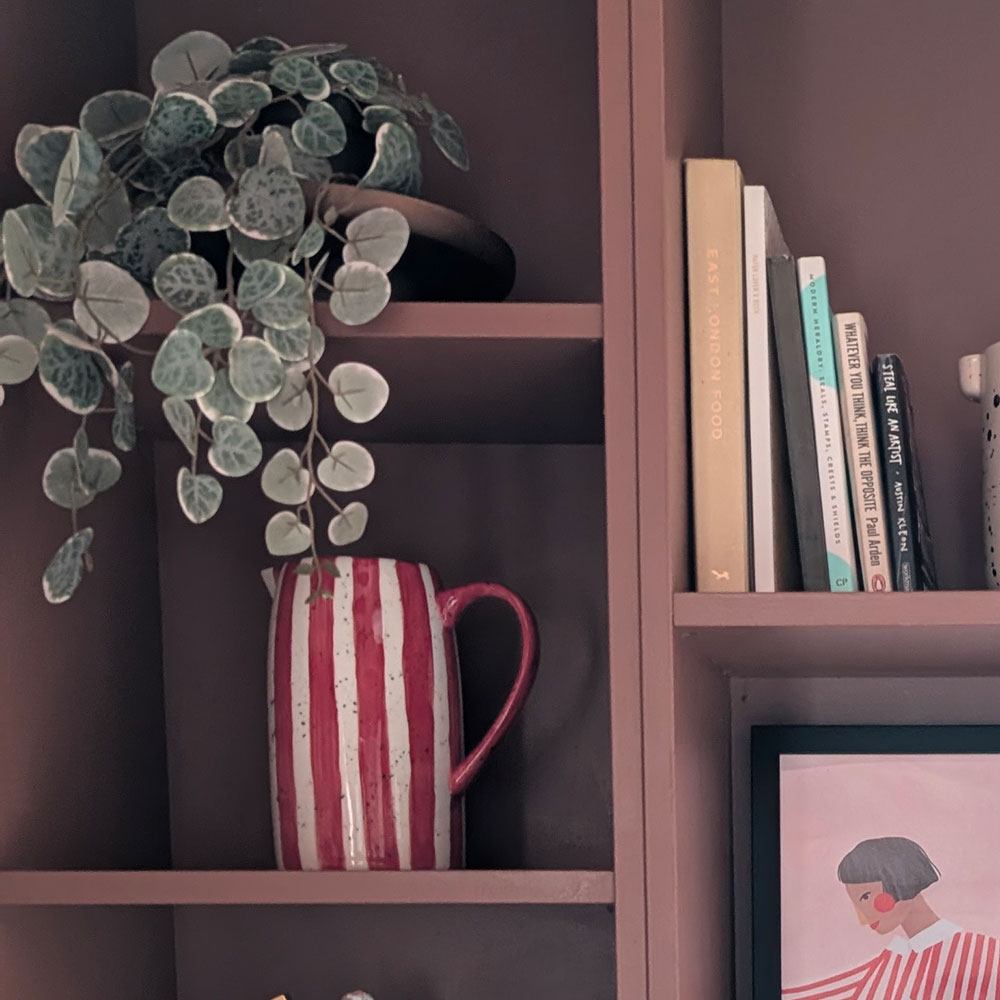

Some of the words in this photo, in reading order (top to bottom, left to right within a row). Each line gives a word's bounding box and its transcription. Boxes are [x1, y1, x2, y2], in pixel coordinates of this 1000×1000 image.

[707, 249, 720, 296] EAST
[708, 303, 722, 382] ONDON
[844, 322, 861, 370] WHATEVER
[850, 371, 863, 390] YOU
[882, 364, 897, 391] STEAL
[711, 390, 723, 440] FOOD
[809, 274, 818, 314] MODERN
[826, 456, 837, 491] CRESTS
[832, 504, 841, 545] SHIELDS
[852, 392, 867, 422] THINK,
[885, 395, 899, 414] LIKE
[856, 422, 870, 450] THINK
[887, 418, 899, 432] AN
[858, 451, 872, 468] THE
[888, 433, 902, 465] ARTIST
[861, 470, 877, 513] OPPOSITE
[894, 481, 905, 513] AUSTIN
[866, 517, 880, 538] Paul
[897, 517, 908, 552] KLEON
[868, 540, 881, 567] Arden
[835, 577, 848, 587] CP
